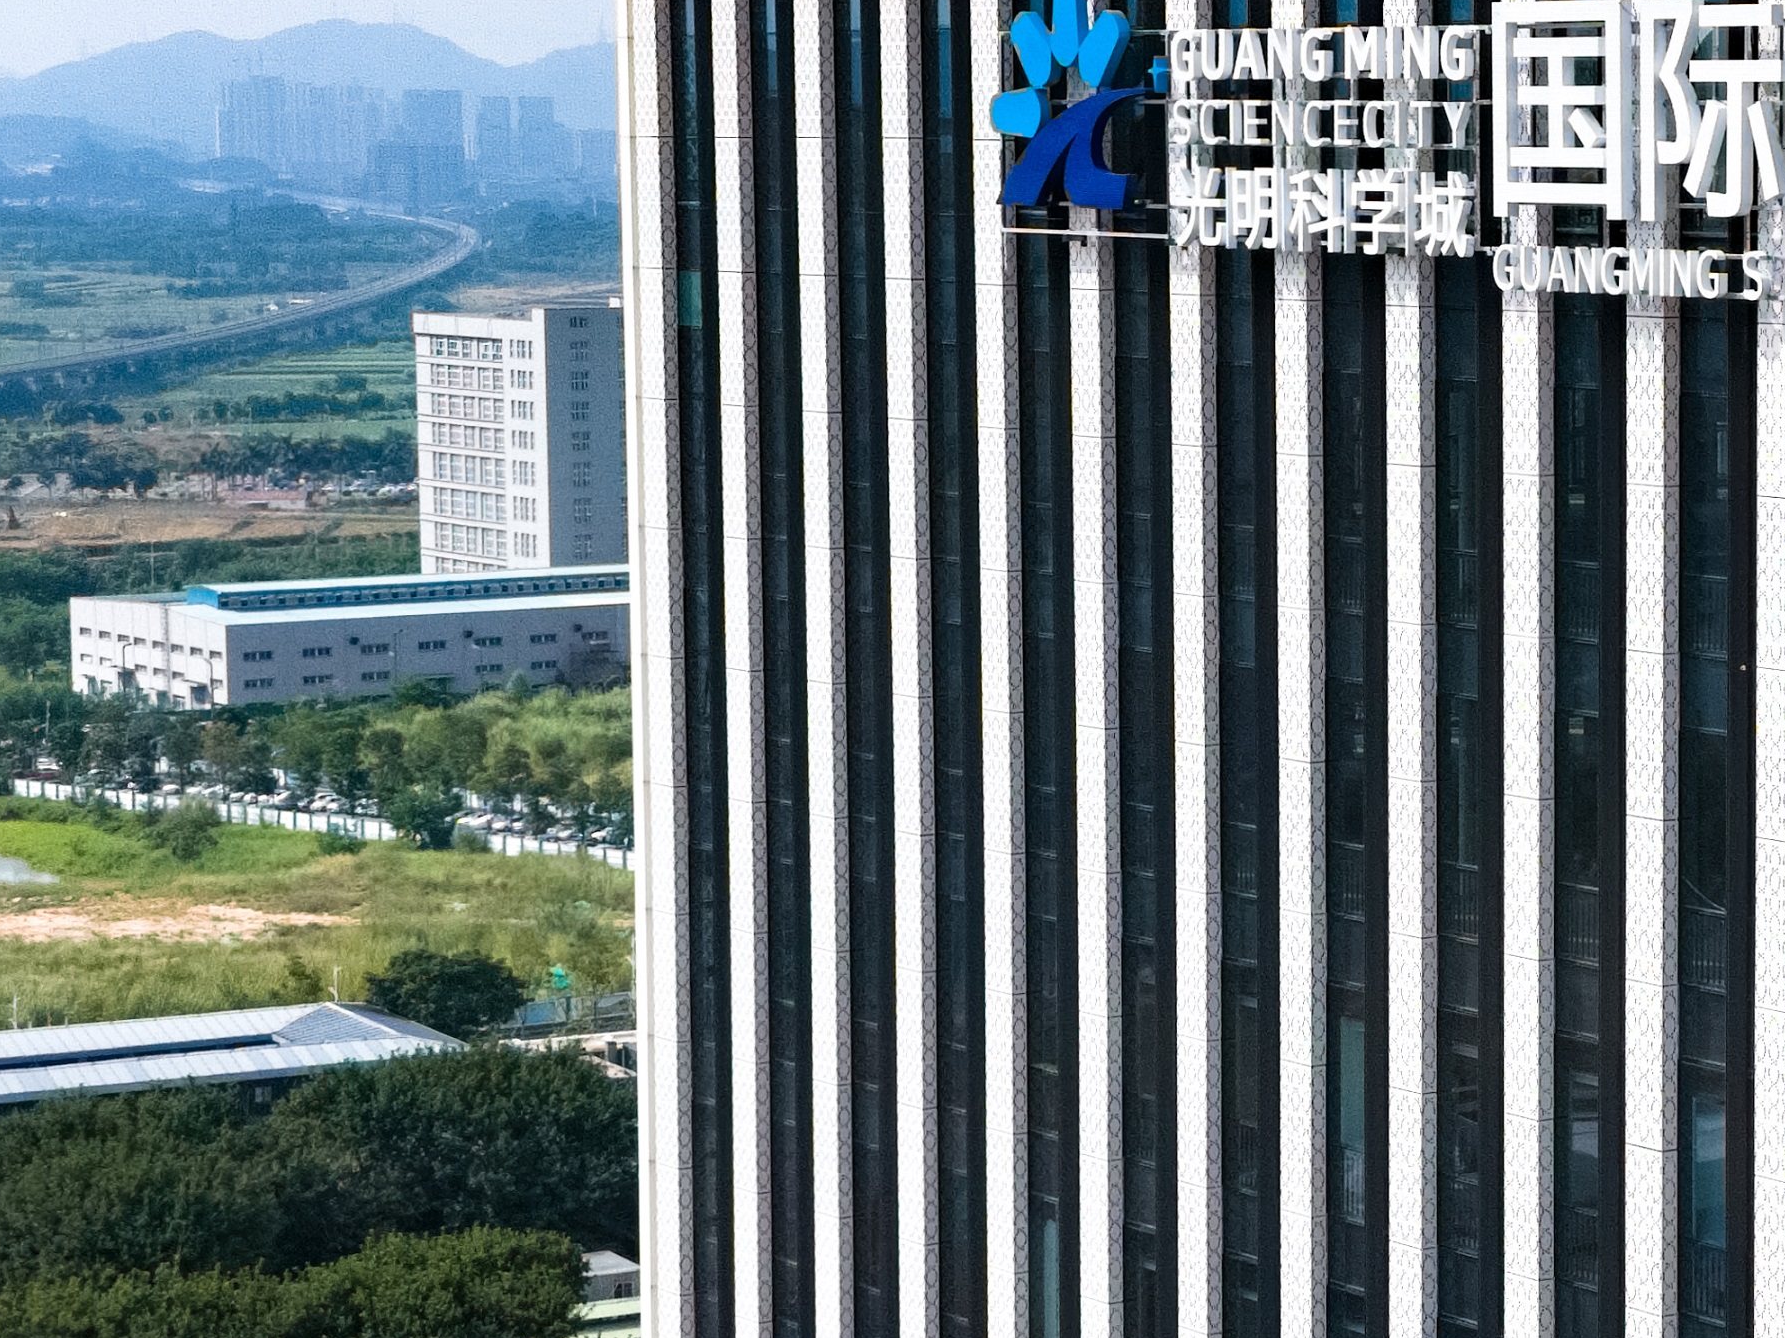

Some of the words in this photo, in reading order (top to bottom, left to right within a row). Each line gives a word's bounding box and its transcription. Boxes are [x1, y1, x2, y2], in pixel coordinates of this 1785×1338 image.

[1169, 161, 1475, 257] 光明科学城
[1493, 245, 1728, 299] GUANGMING
